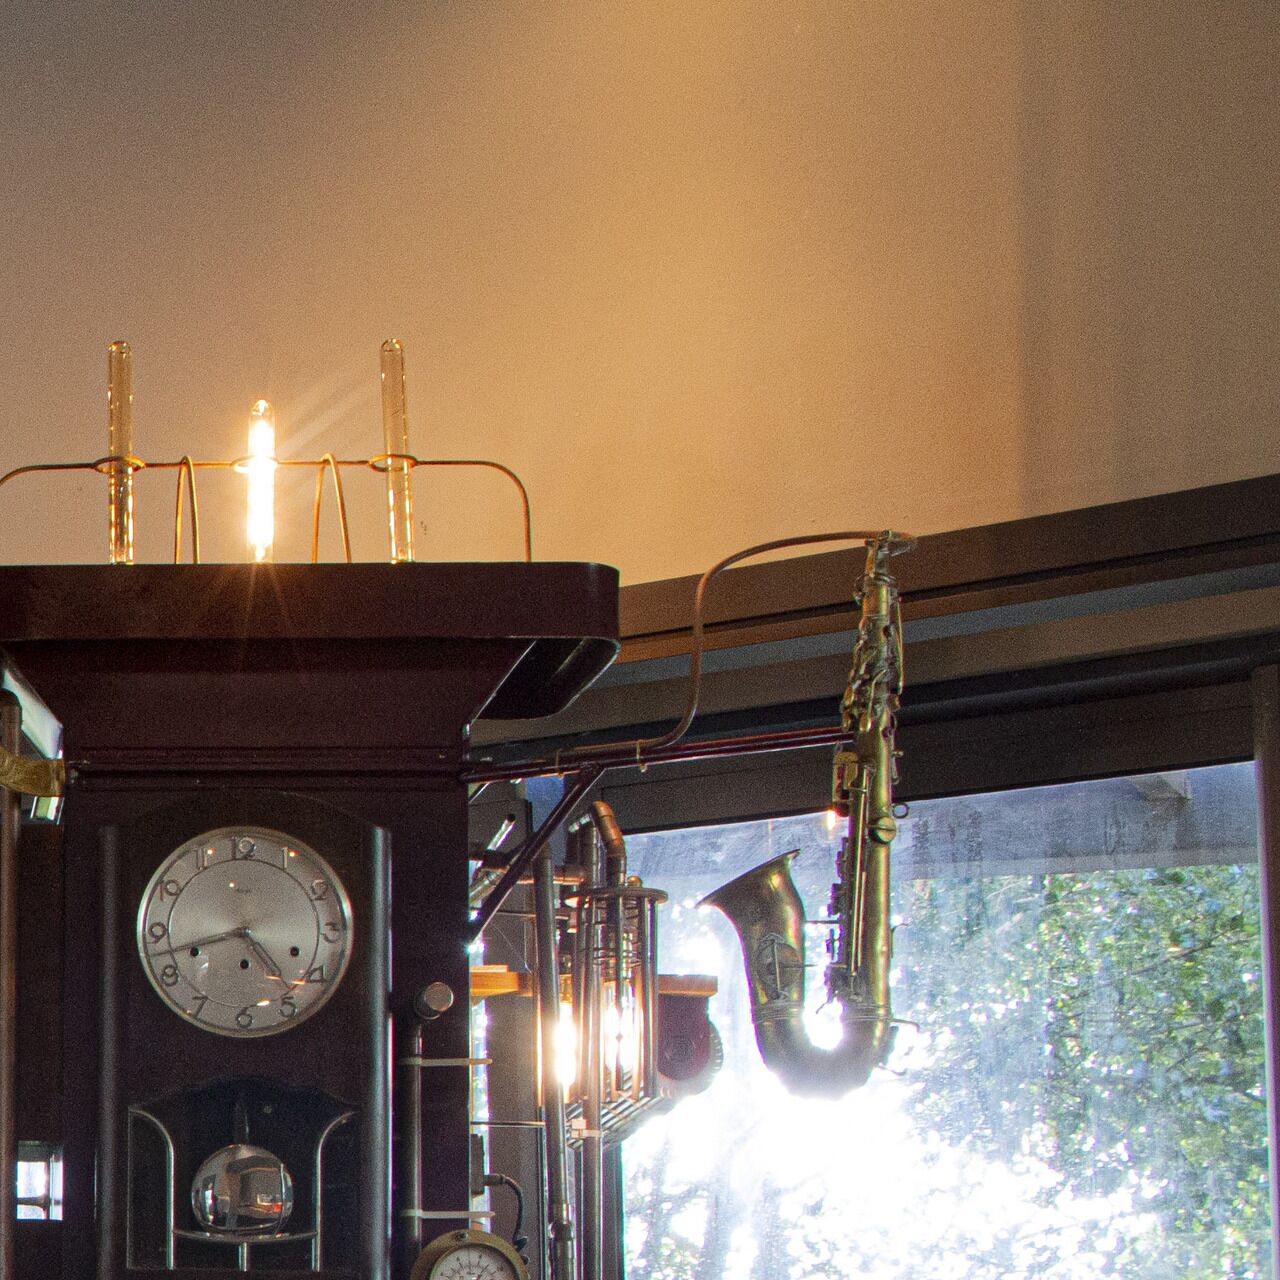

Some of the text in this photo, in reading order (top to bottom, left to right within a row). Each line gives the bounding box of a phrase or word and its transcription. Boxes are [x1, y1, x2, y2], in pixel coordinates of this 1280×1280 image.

[195, 847, 209, 871] 11
[231, 835, 257, 860] 12
[281, 846, 289, 869] 1
[157, 878, 182, 902] 10
[310, 878, 329, 901] 2
[148, 921, 167, 945] 9
[320, 921, 340, 944] 3
[160, 964, 180, 987] 8
[307, 964, 326, 984] 4
[192, 996, 209, 1018] 7
[235, 1005, 253, 1030] 6
[278, 996, 298, 1018] 5
